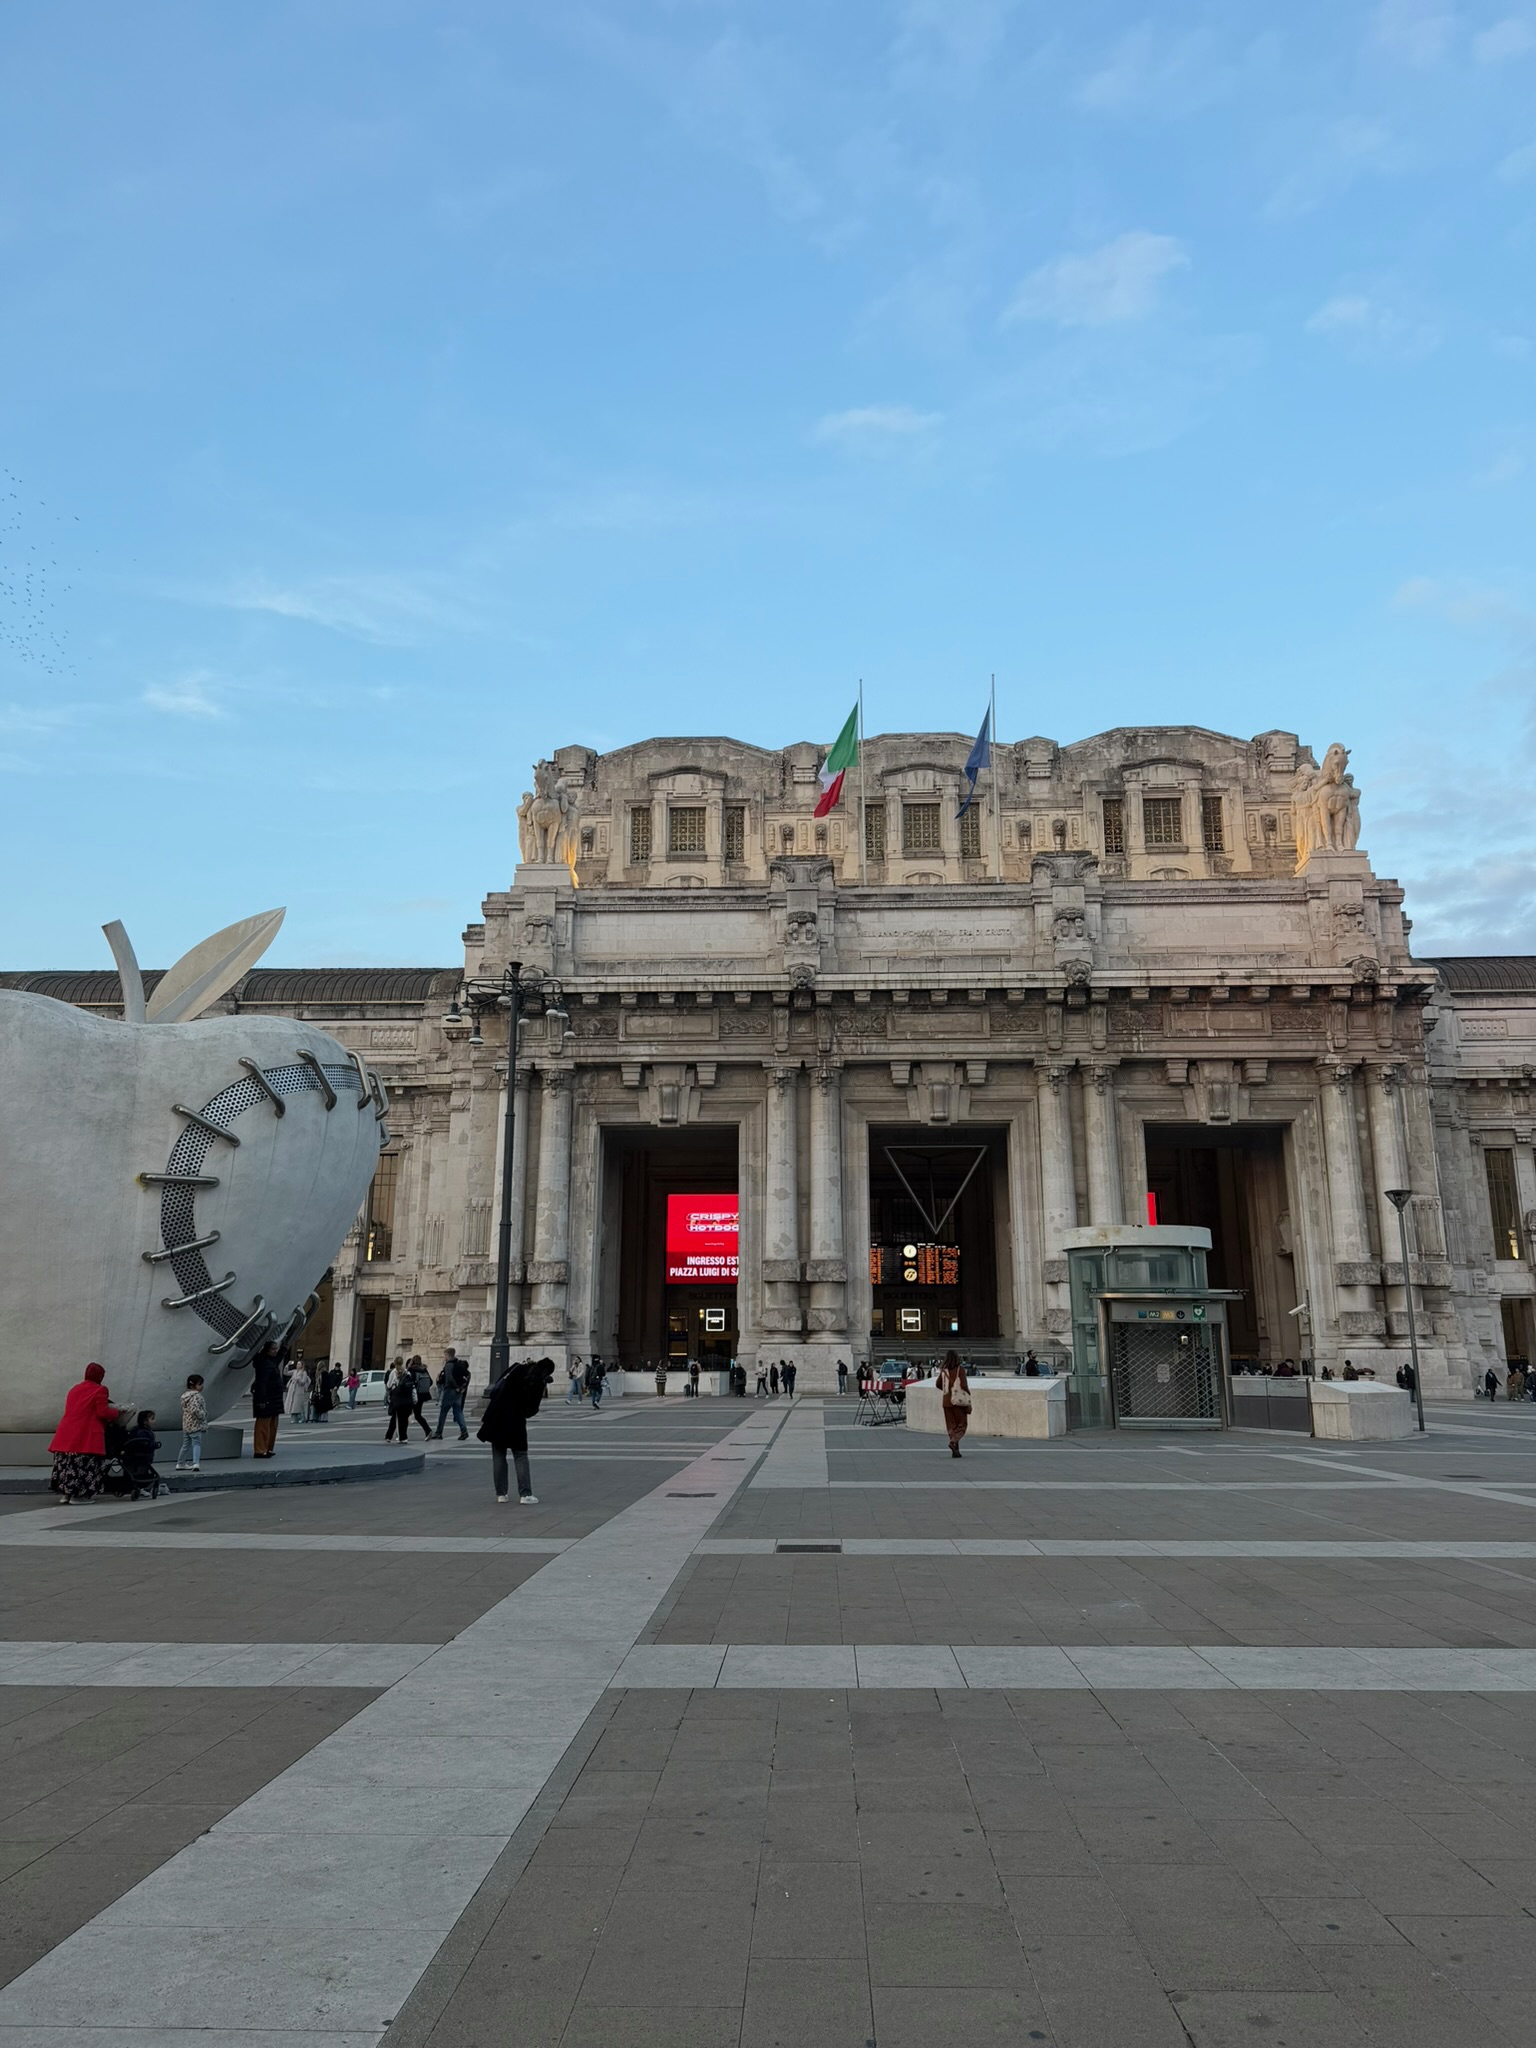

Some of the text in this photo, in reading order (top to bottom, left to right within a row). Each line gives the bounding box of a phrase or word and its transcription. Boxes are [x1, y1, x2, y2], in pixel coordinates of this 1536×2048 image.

[687, 1256, 725, 1265] INGRESSO
[670, 1267, 698, 1276] PIAZZA
[699, 1267, 719, 1276] LUIGI
[721, 1267, 729, 1276] DI
